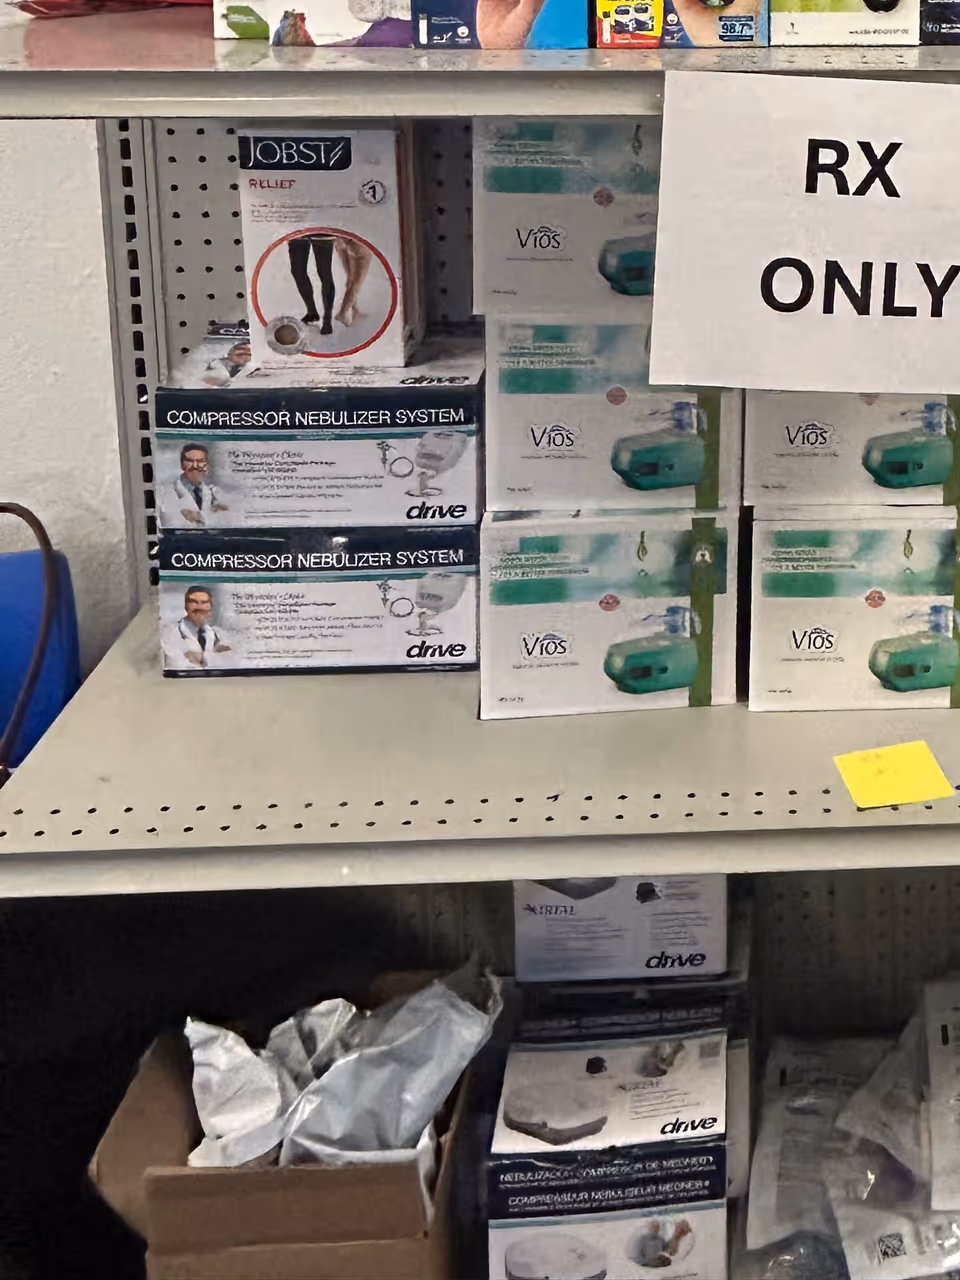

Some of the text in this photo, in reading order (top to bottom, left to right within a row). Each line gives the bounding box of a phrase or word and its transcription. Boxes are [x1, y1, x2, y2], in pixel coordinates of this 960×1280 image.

[249, 141, 330, 167] JOBST
[804, 138, 903, 198] RX
[249, 178, 296, 190] RELIEF
[516, 227, 561, 250] Vios
[167, 408, 465, 426] COMPRESSOR NEBULIZER SYSTEM
[530, 424, 575, 448] Vios
[785, 422, 829, 446] Vios
[406, 501, 467, 520] drive
[171, 549, 464, 569] COMPRESSOR NEBULIZER SYSTEM
[522, 632, 568, 657] Vios
[791, 627, 835, 651] Vios
[406, 640, 467, 660] drive
[645, 951, 707, 969] drive
[660, 1116, 719, 1135] drive
